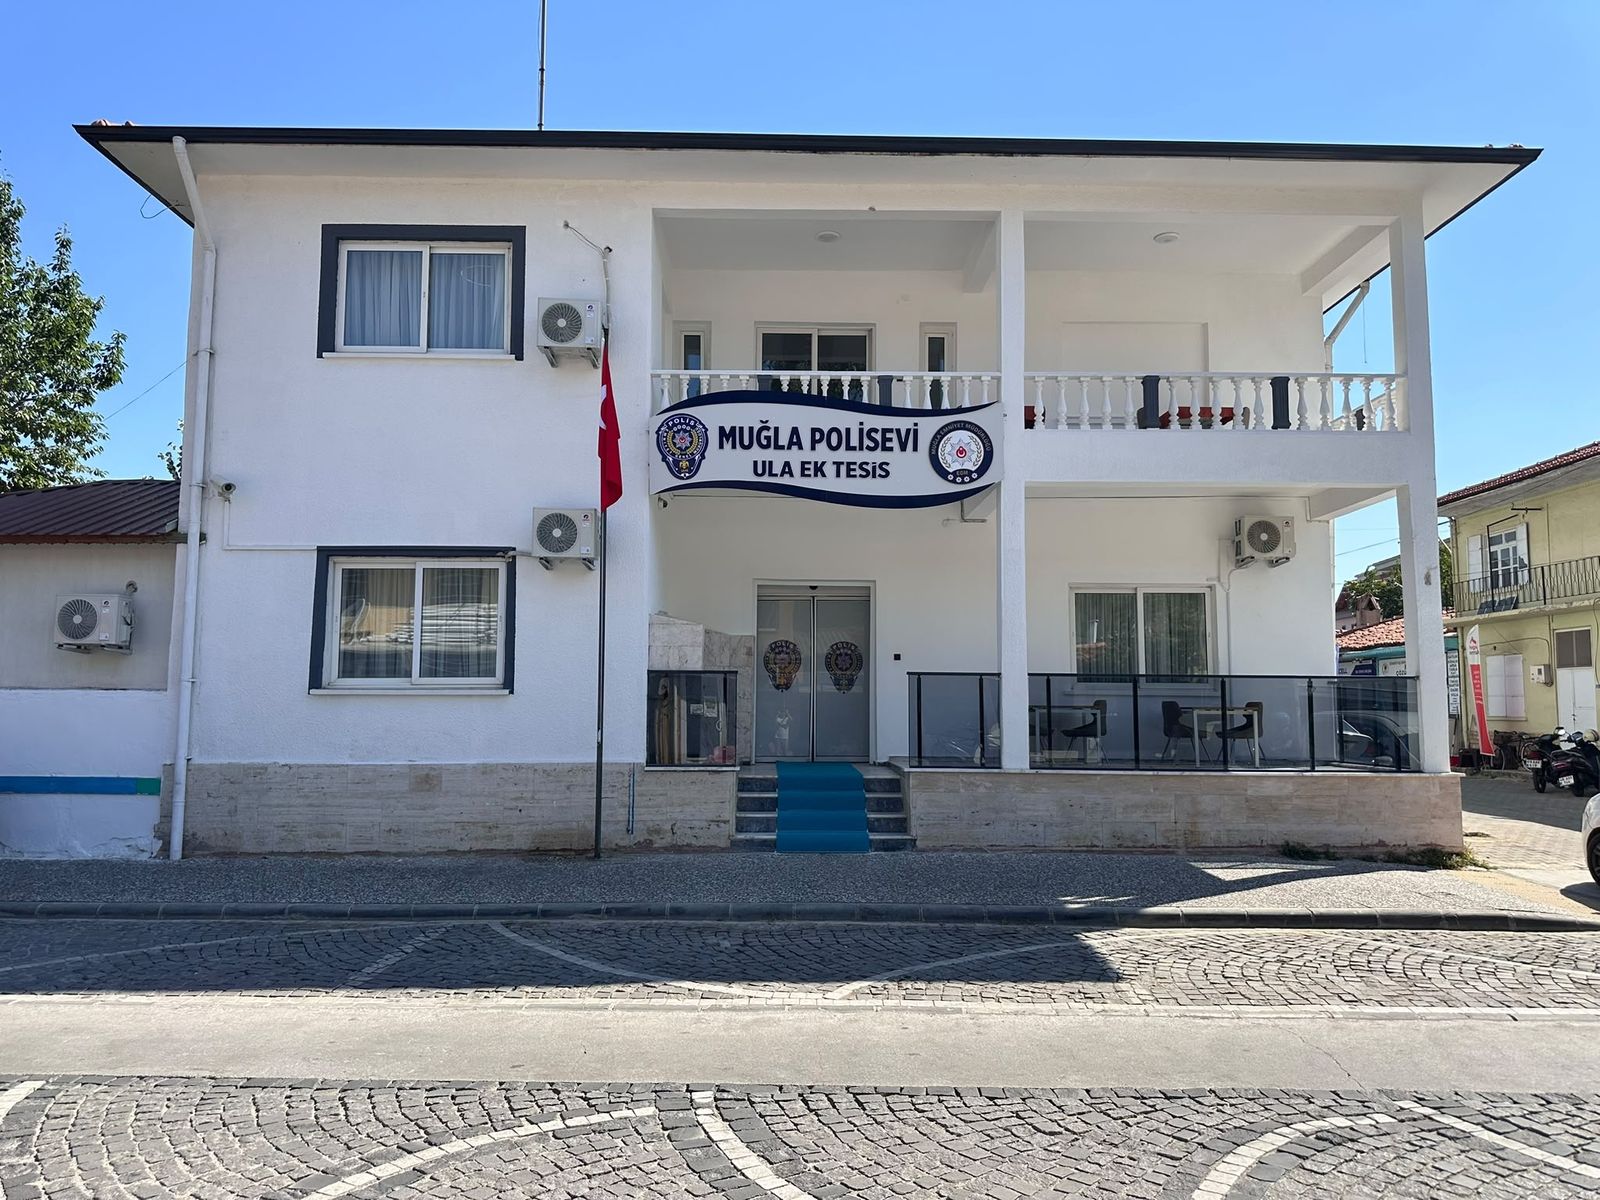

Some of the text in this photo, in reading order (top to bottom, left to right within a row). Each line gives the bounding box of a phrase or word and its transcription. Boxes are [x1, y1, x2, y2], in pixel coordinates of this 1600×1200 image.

[718, 419, 804, 451] MUĞLA
[810, 421, 919, 452] POLİSEVİ
[752, 460, 794, 478] ULA
[800, 460, 827, 478] EK
